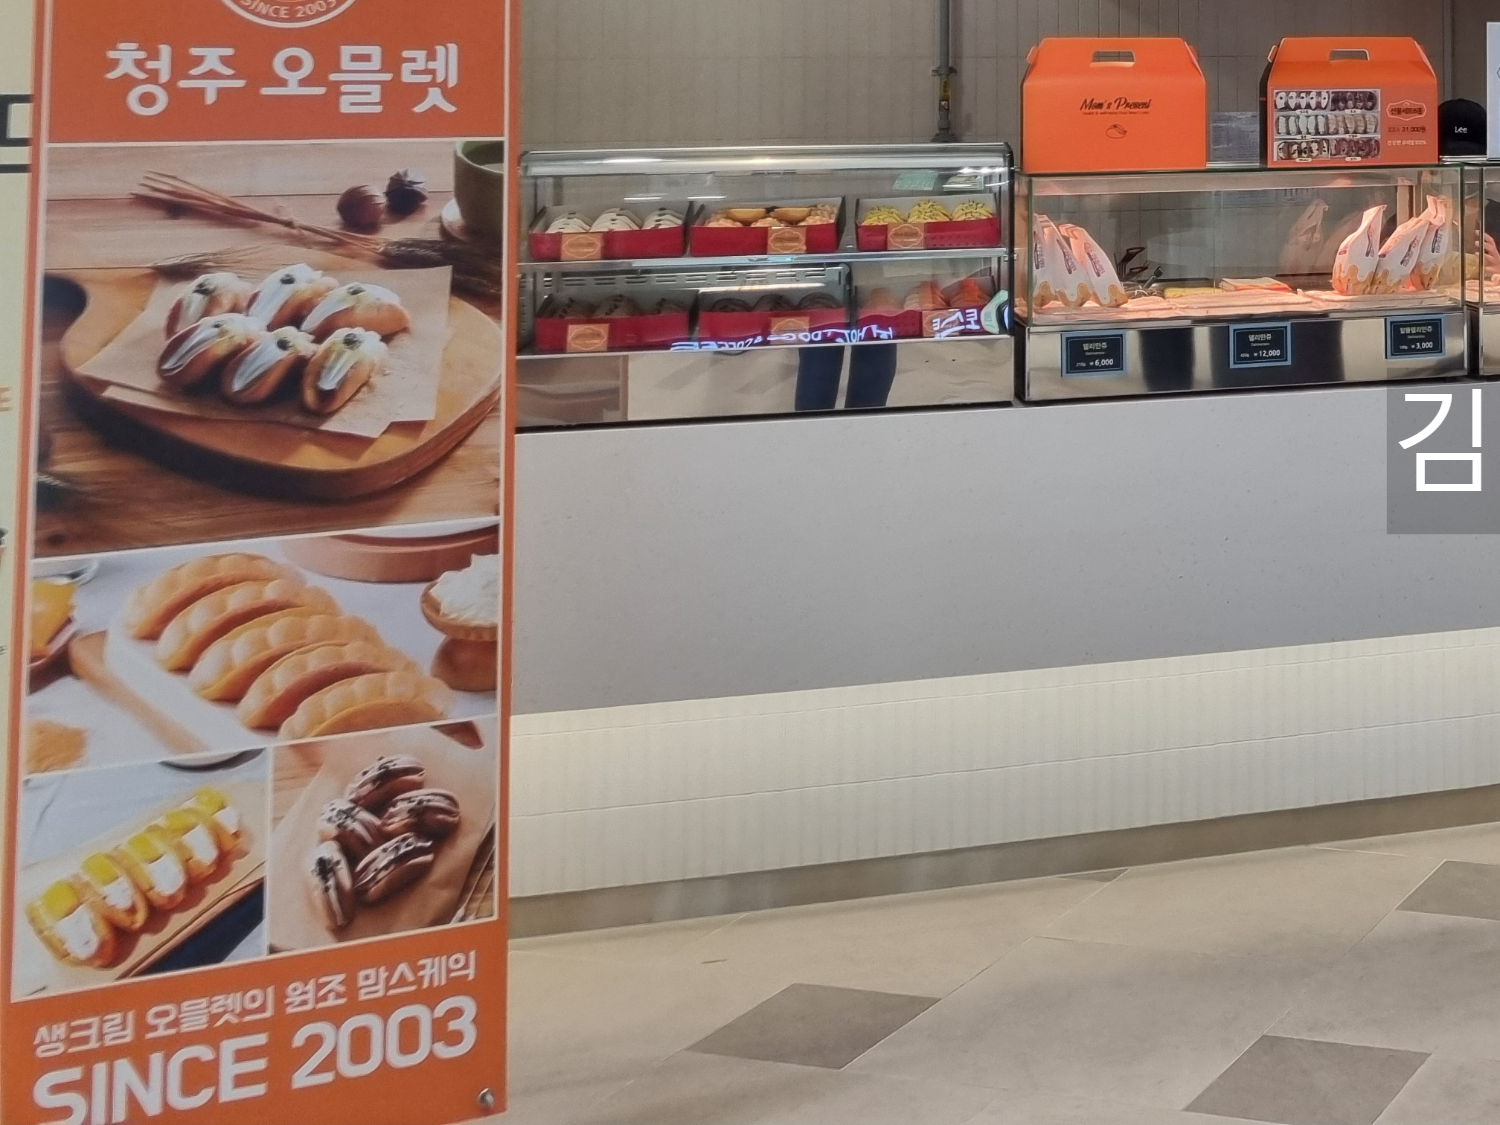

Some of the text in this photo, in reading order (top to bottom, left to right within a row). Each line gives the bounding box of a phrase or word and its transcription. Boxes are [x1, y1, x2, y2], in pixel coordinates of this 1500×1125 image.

[106, 41, 460, 116] 청주 오믈렛
[1080, 97, 1152, 111] Mom's Present
[33, 1010, 133, 1058] 생크림
[145, 985, 275, 1039] 오믈렛의
[284, 973, 348, 1013] 원조
[32, 995, 477, 1125] SINCE 2003
